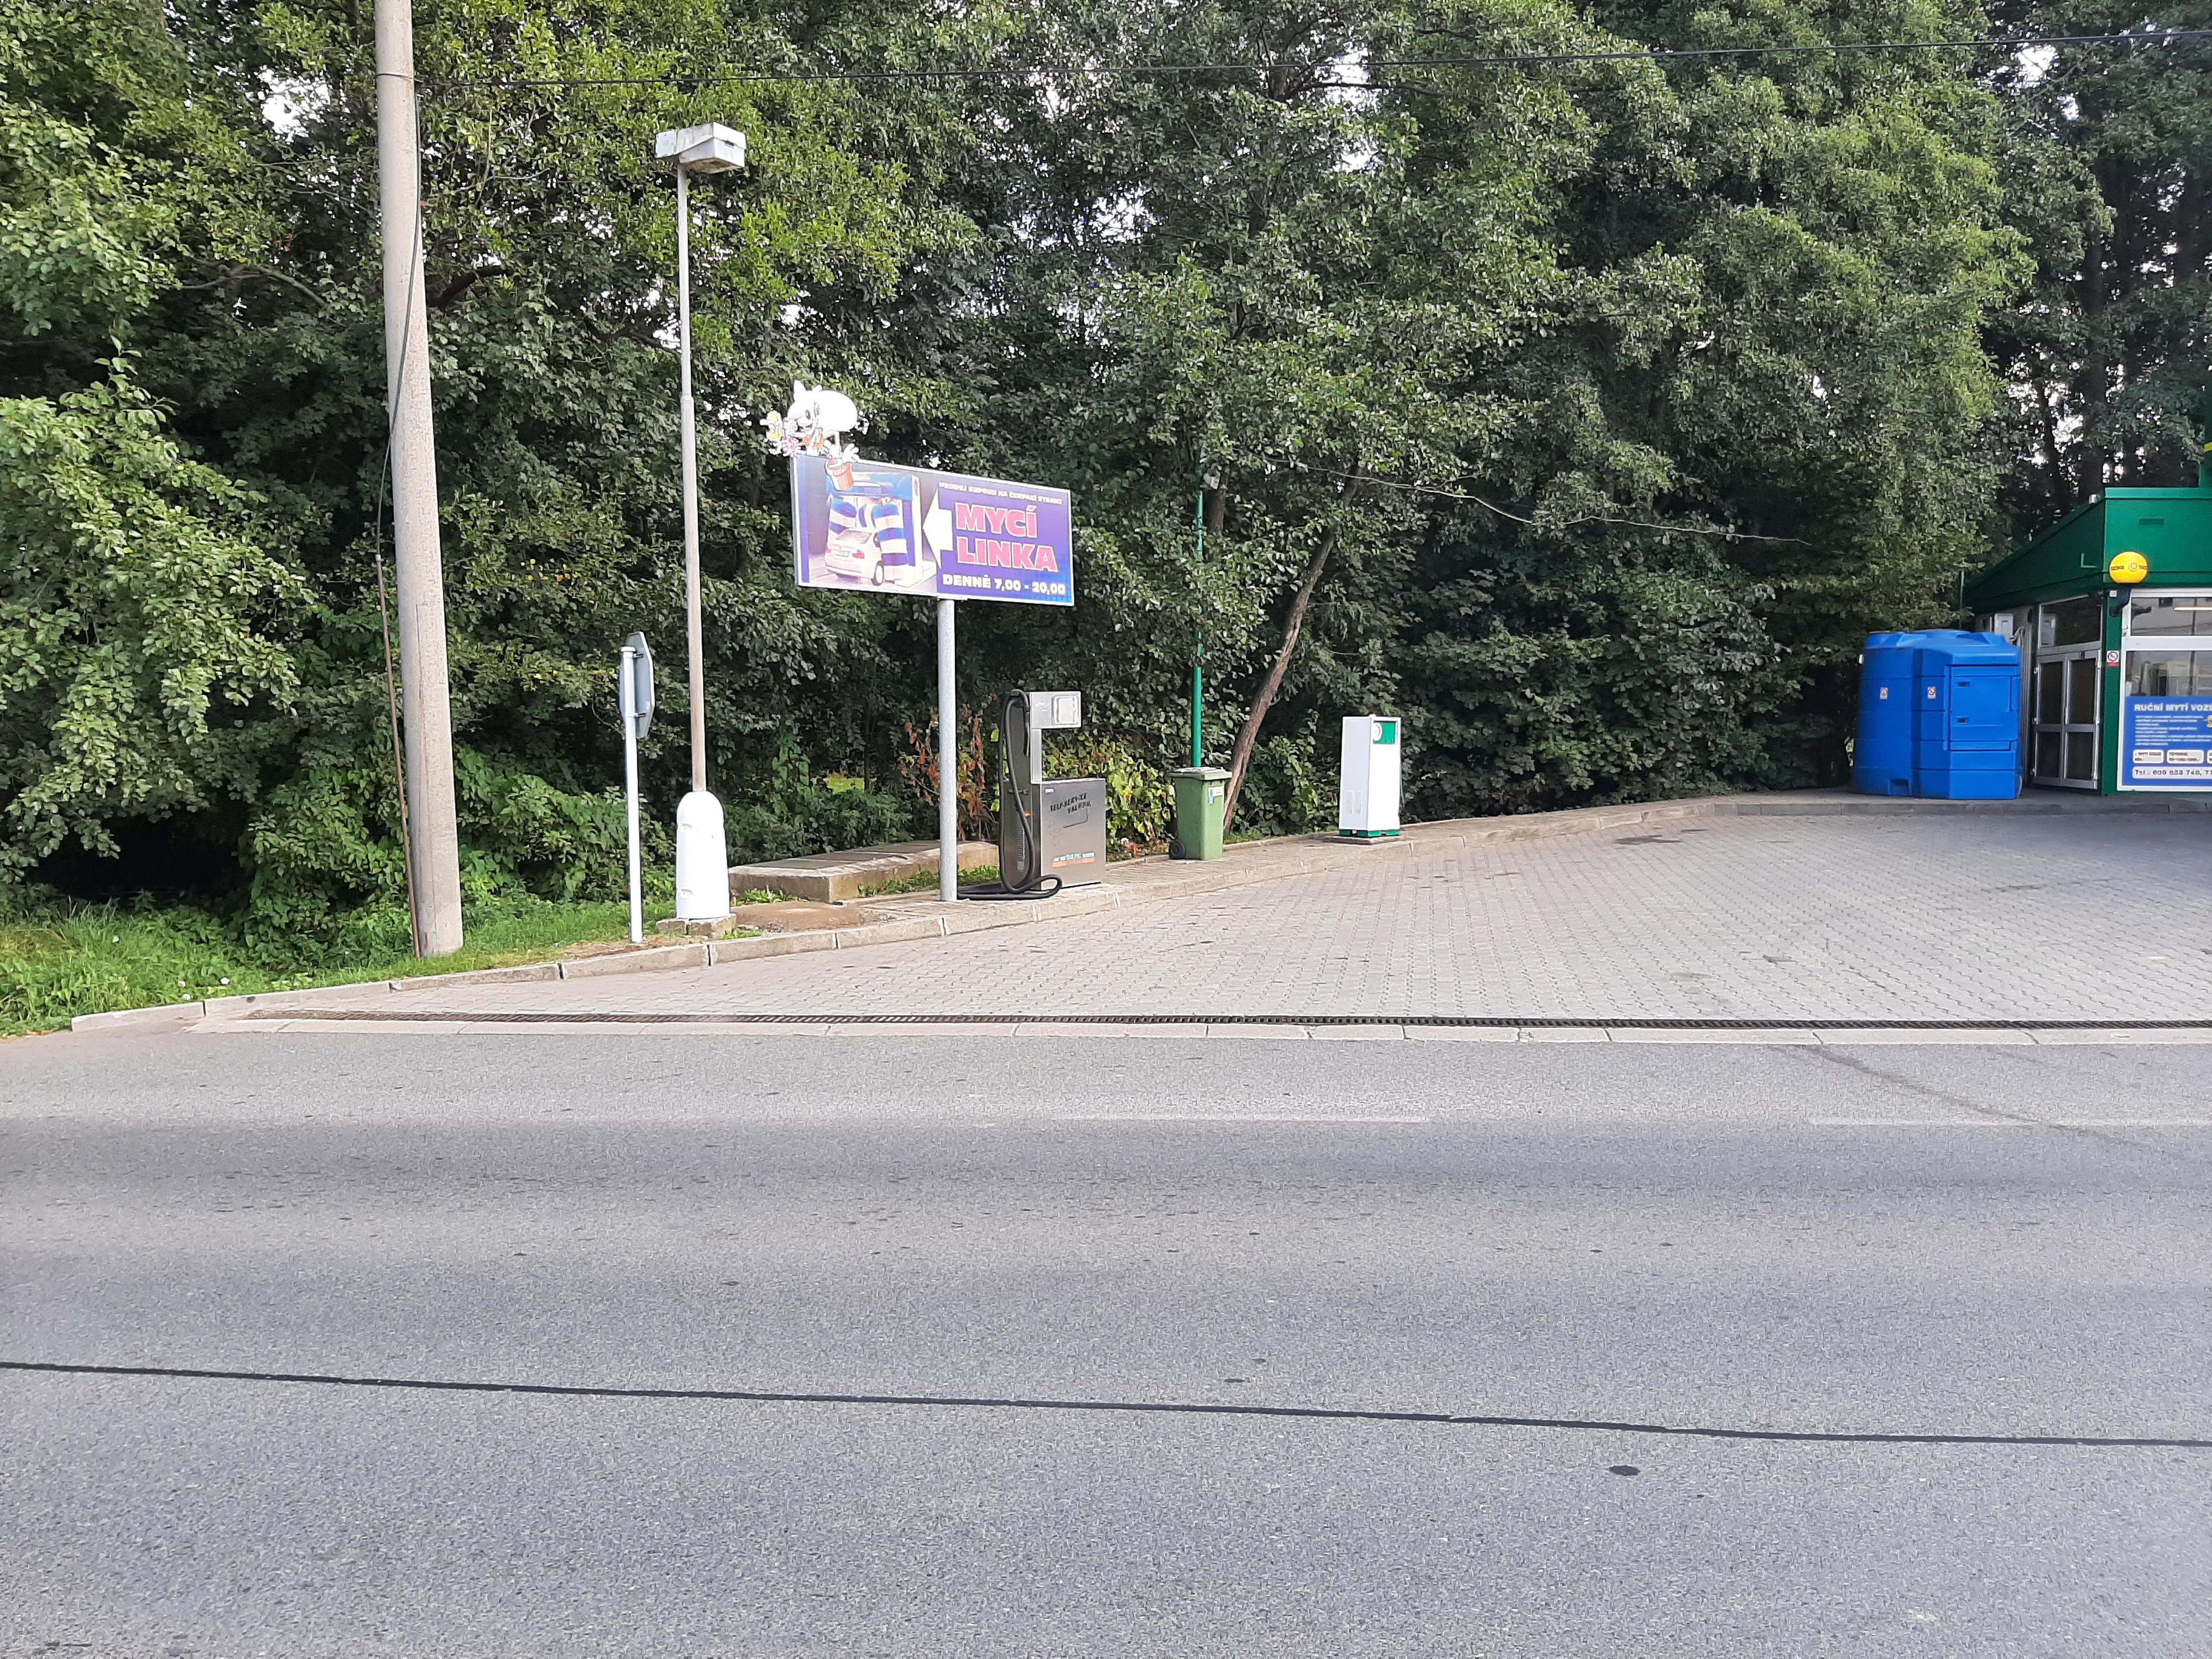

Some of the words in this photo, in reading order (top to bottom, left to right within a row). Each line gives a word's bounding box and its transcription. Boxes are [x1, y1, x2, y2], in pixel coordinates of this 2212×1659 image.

[955, 502, 1037, 538] MYCÍ
[956, 536, 1059, 572] LINKA
[994, 578, 1021, 591] 7,00
[1032, 582, 1066, 595] 20,00
[2135, 702, 2163, 711] RUČNÍ
[2166, 702, 2189, 711] MYTÍ
